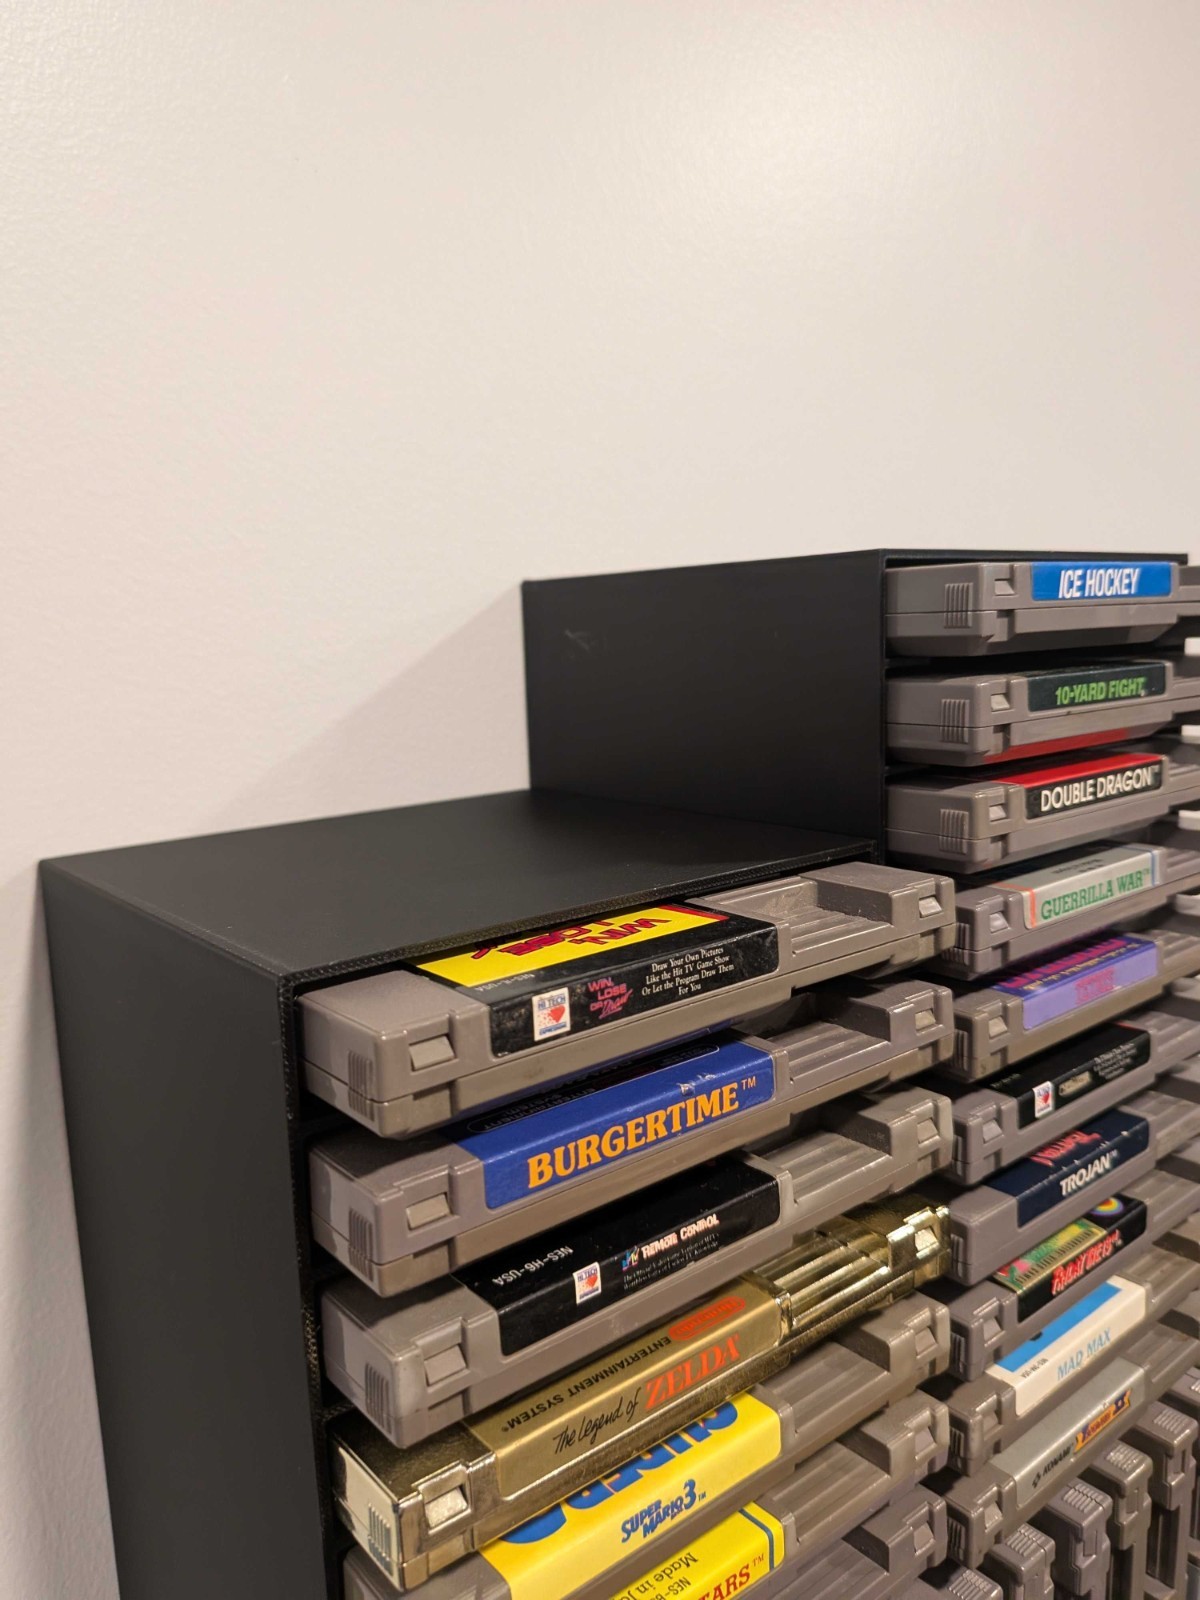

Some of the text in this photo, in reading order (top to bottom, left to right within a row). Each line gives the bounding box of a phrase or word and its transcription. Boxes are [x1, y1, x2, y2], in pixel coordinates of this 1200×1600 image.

[1058, 567, 1140, 599] ICE HOCKEY
[1055, 676, 1146, 706] 10-YARD FIGHT
[1040, 779, 1097, 812] DOUBLE
[1097, 766, 1152, 798] DRAGON
[1040, 880, 1114, 920] GUERRILLA
[1116, 870, 1144, 894] WAR
[641, 962, 735, 996] Or Let the Program Draw Them
[645, 974, 660, 985] Like
[661, 971, 672, 981] the
[672, 967, 683, 978] Hit
[696, 960, 714, 970] Game
[714, 955, 730, 966] Show
[651, 947, 724, 974] Draw Your Own Pictures
[597, 982, 628, 1001] LOSE
[678, 981, 702, 996] For You
[527, 1082, 739, 1189] BURGERTIME
[1059, 1152, 1111, 1197] TROJAN
[680, 1213, 720, 1241] CONTROL
[492, 1244, 574, 1287] NES-H6-USA
[567, 1336, 672, 1398] ENTERTAINMENT
[1056, 1328, 1111, 1381] MAD MAX
[552, 1335, 740, 1455] The Legend of ZELDA
[621, 1498, 662, 1544] SUPER
[642, 1495, 684, 1539] MARIO
[683, 1478, 697, 1511] 3
[653, 1551, 699, 1583] Made
[634, 1579, 656, 1594] in
